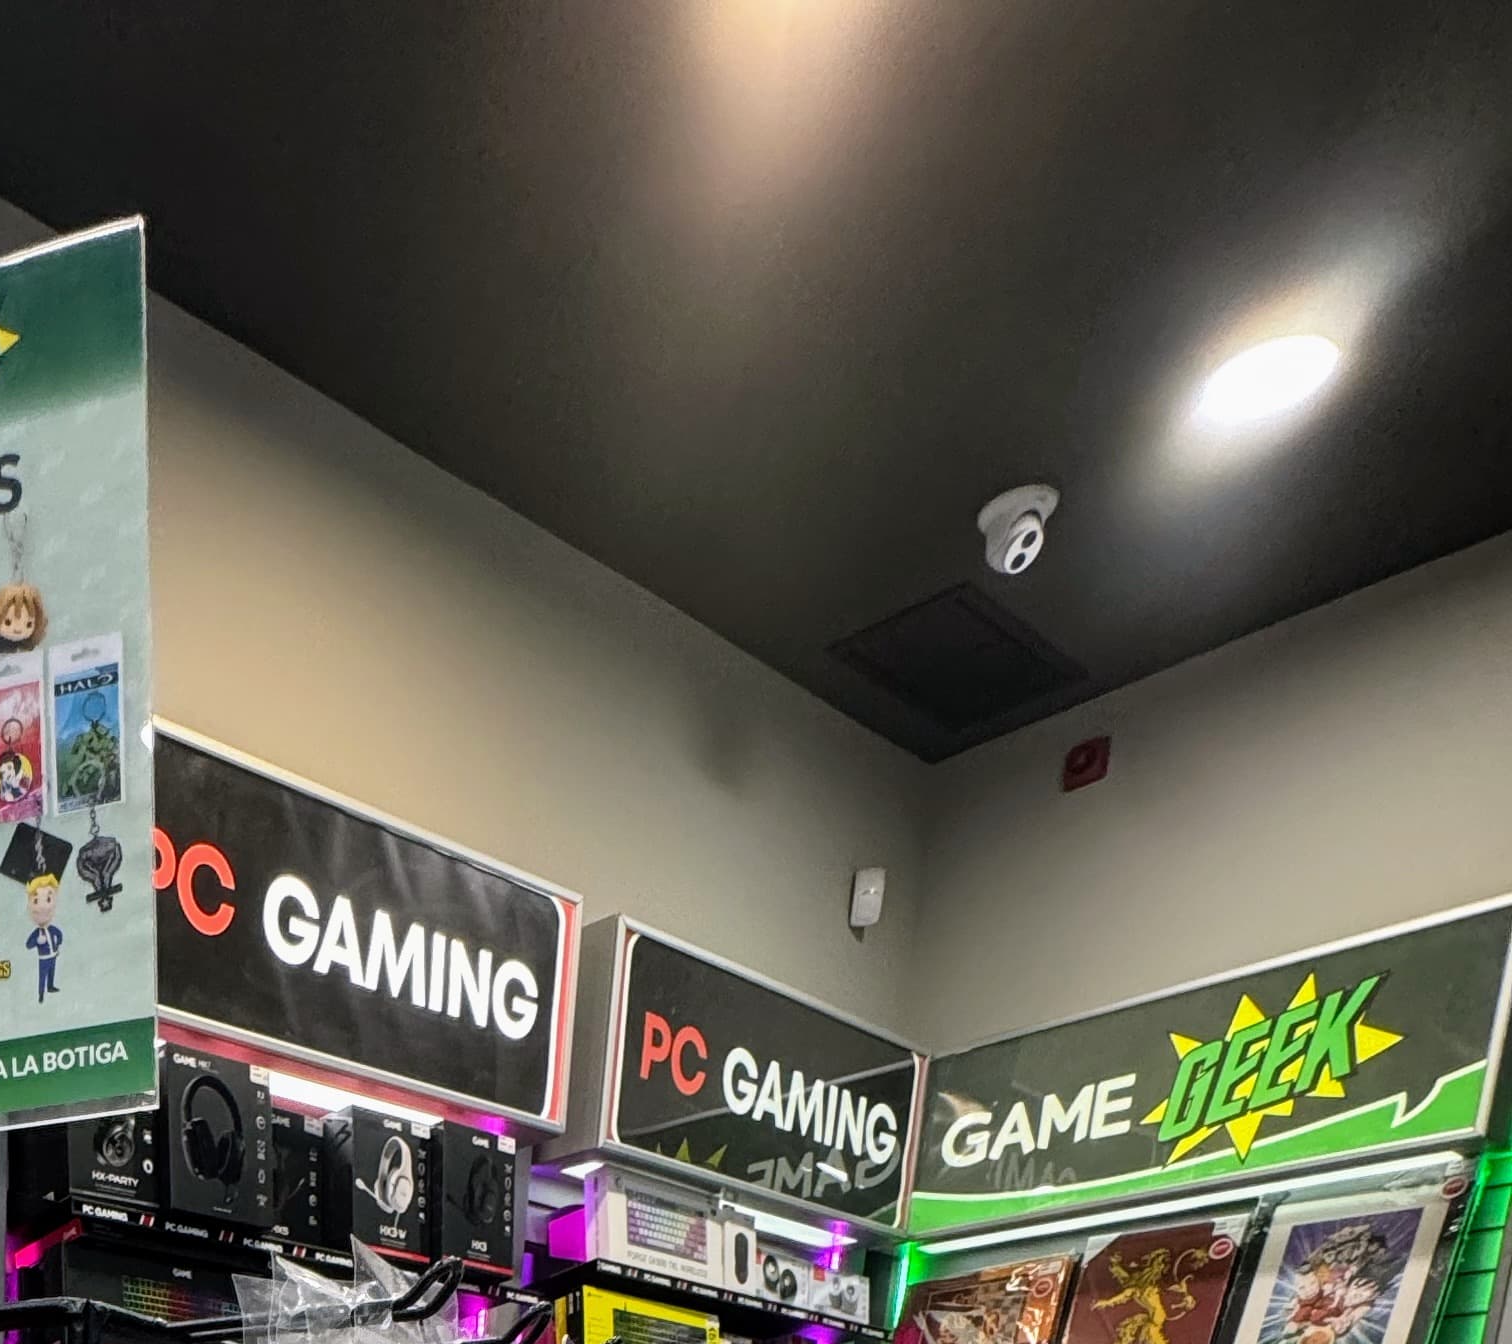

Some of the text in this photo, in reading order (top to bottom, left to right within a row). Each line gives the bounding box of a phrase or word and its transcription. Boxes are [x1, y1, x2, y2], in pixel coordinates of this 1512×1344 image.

[262, 873, 539, 1041] GAMING
[12, 1055, 39, 1077] LA
[42, 1041, 128, 1074] BOTIGA
[172, 1052, 197, 1068] GAME
[940, 971, 1390, 1169] GAME GEEK
[640, 1011, 898, 1165] PC GAMING
[91, 1169, 139, 1190] HX-PARTY
[82, 1203, 128, 1223] PC GAMING
[178, 1224, 208, 1239] GAMING
